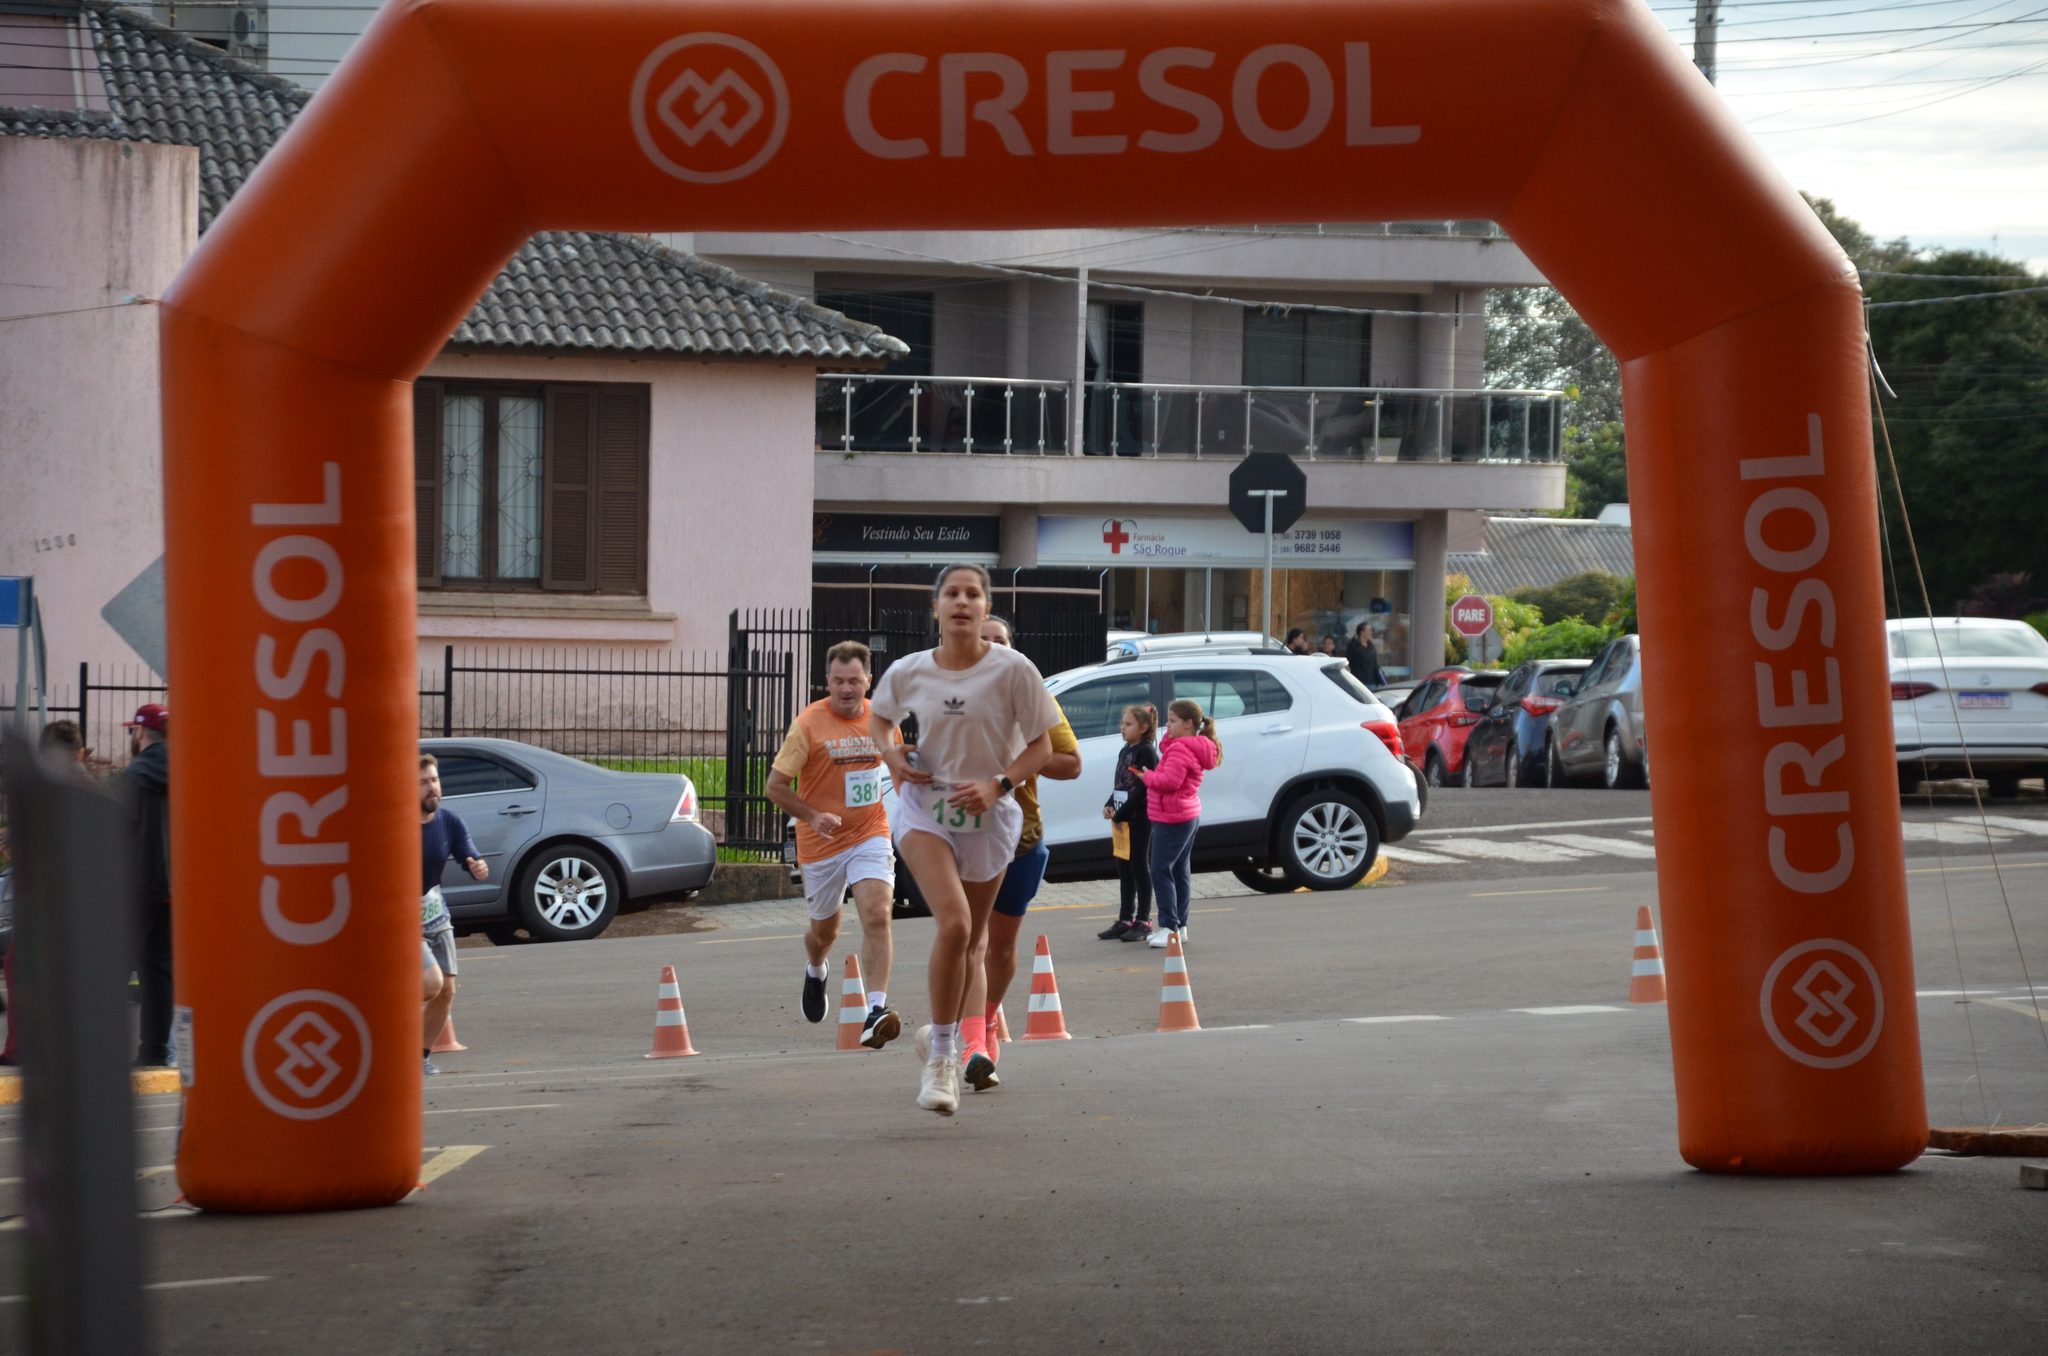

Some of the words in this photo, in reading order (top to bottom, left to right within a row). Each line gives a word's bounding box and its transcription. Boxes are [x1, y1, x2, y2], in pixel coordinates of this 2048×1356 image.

[843, 41, 1422, 160] CRESOL
[862, 525, 910, 541] Vestindo
[913, 525, 934, 541] Seu
[937, 526, 970, 541] Estilo
[1133, 532, 1165, 542] Farmácia
[1294, 530, 1317, 540] 3739
[1133, 543, 1152, 556] São
[1154, 544, 1187, 556] Roque
[1294, 543, 1316, 553] 9682
[1318, 543, 1341, 553] 5446
[1458, 608, 1485, 622] PARE
[1740, 413, 1856, 894] CRESOL
[251, 461, 351, 945] CRESOL
[852, 781, 879, 803] 381
